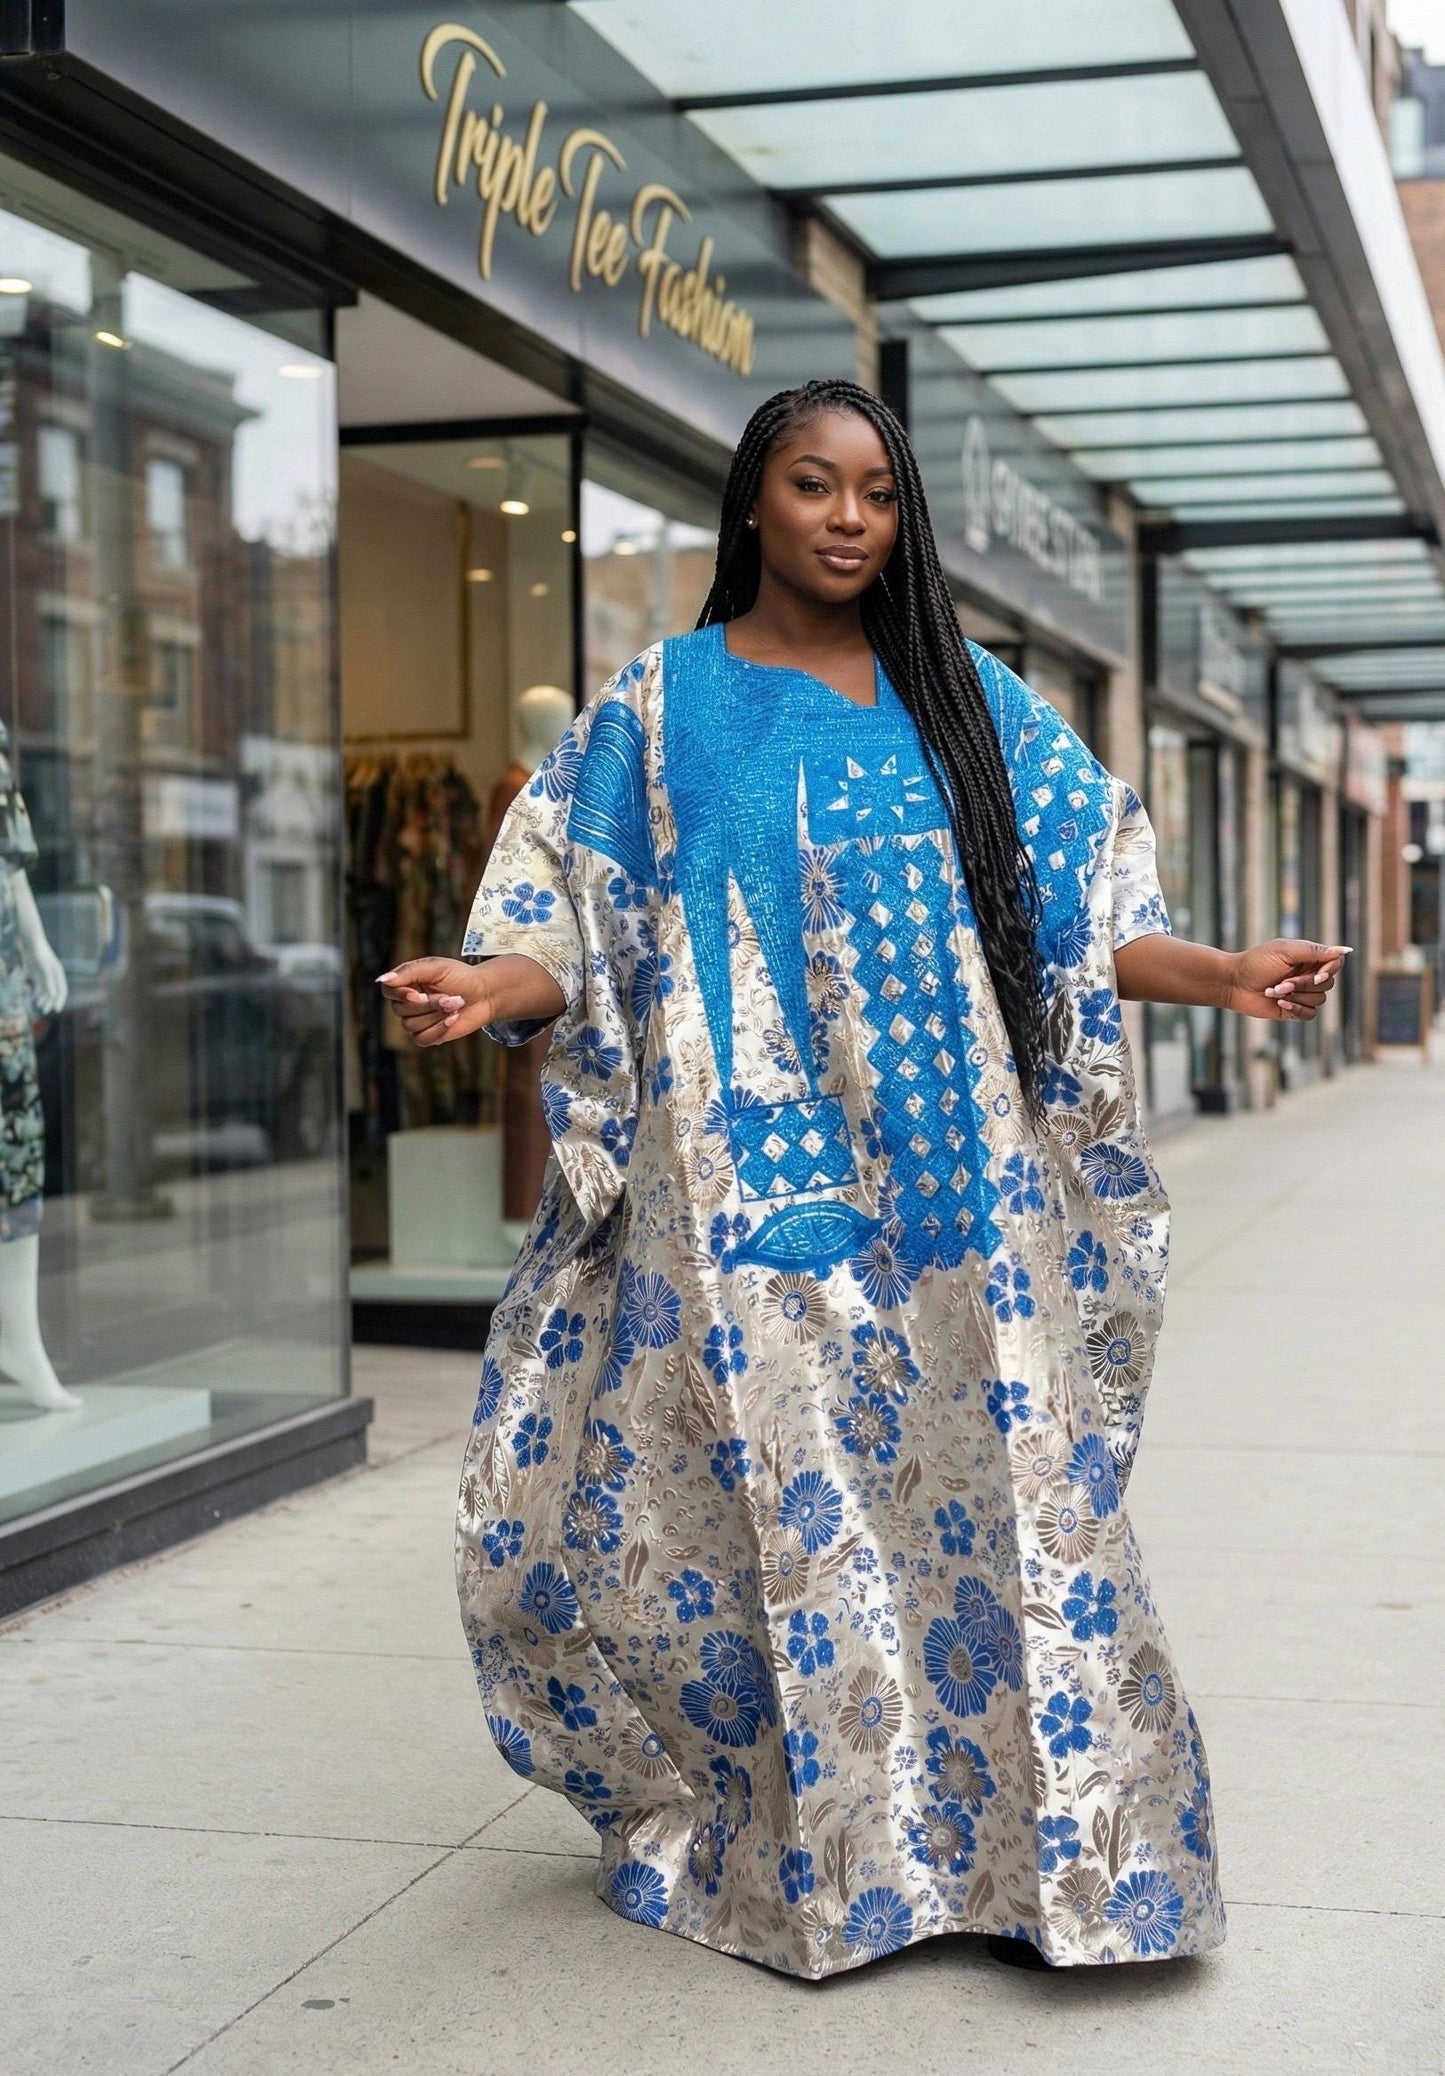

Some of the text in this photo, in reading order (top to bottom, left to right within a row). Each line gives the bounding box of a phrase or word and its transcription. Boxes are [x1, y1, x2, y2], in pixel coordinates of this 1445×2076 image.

[421, 23, 754, 376] Triple Tee Fashion
